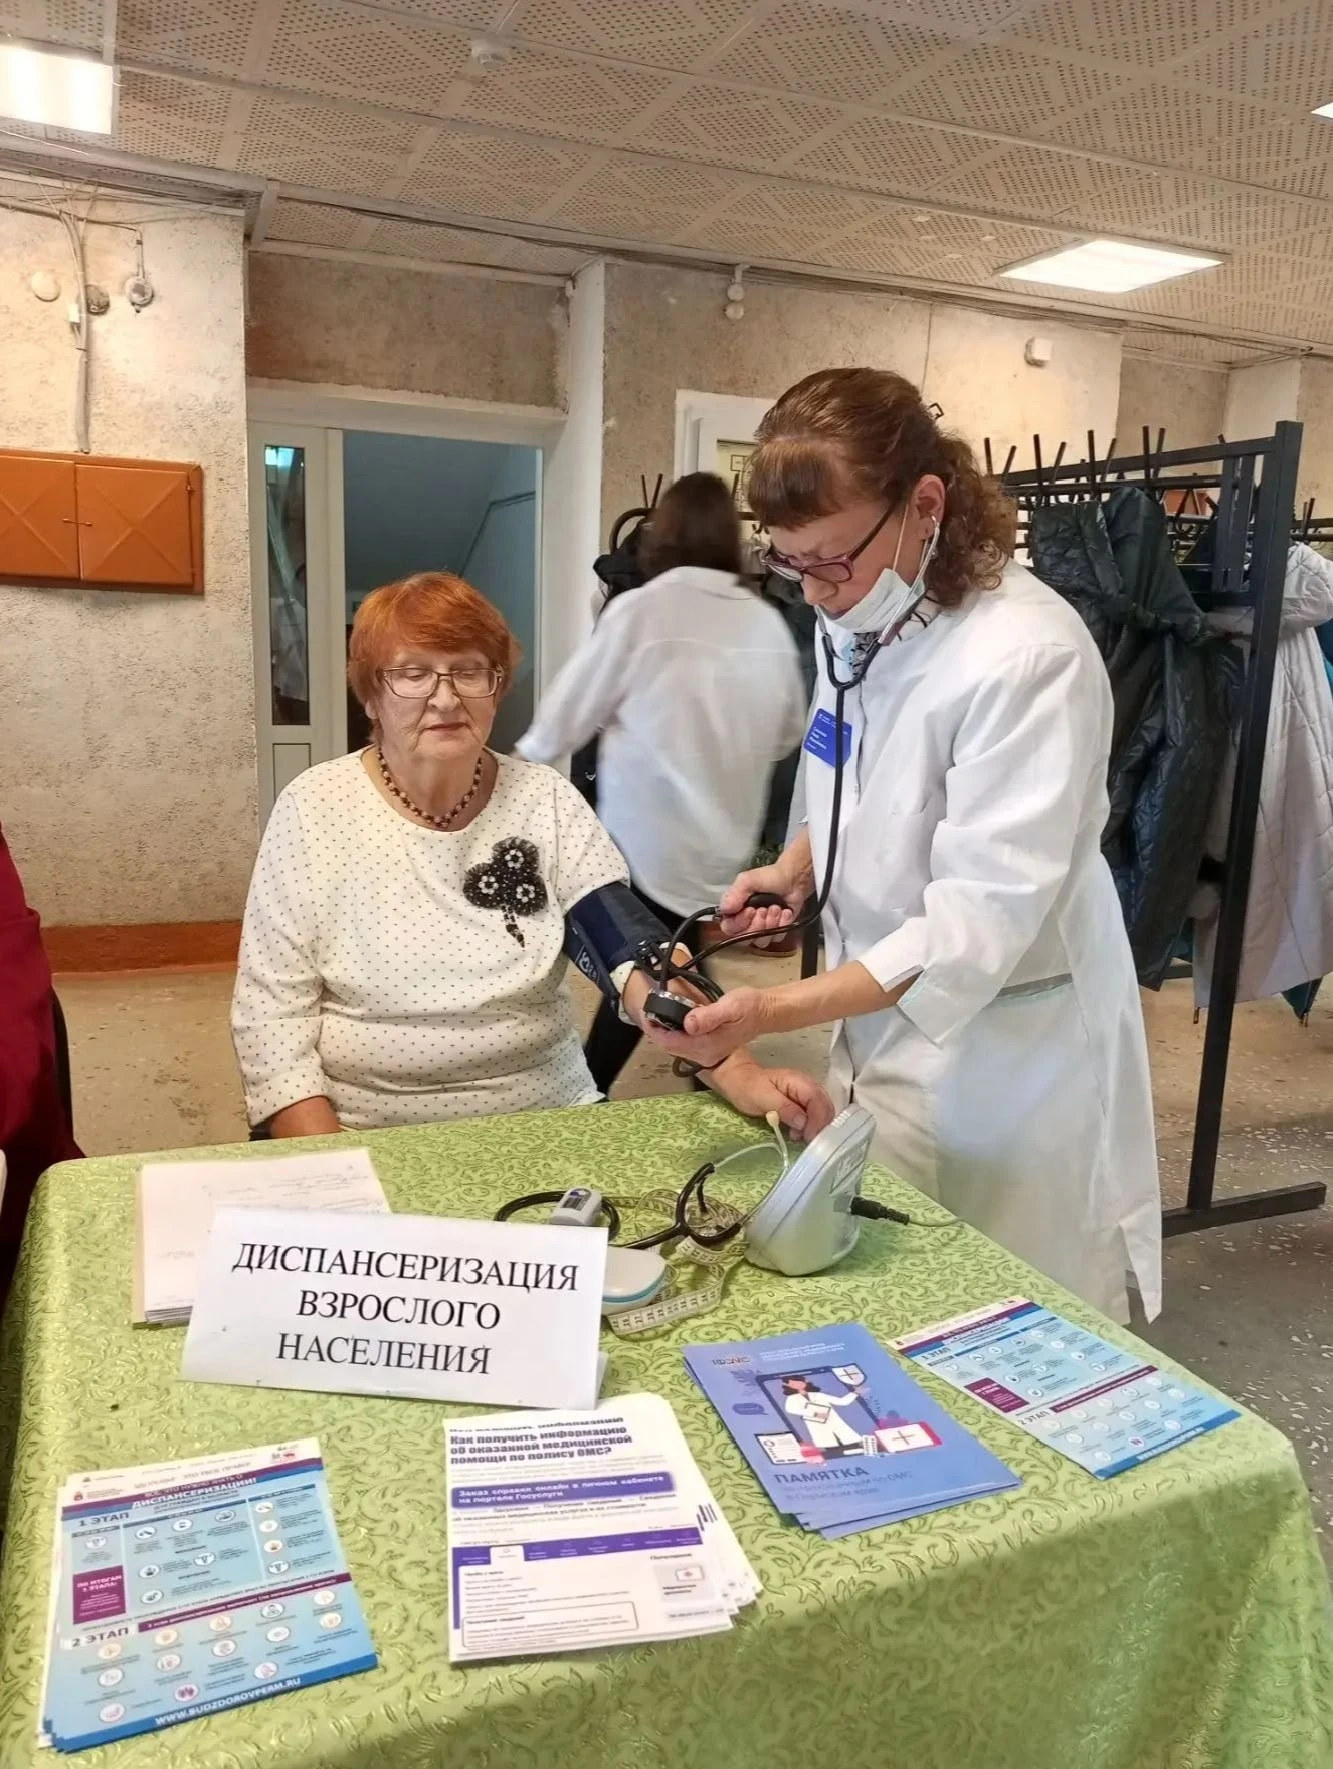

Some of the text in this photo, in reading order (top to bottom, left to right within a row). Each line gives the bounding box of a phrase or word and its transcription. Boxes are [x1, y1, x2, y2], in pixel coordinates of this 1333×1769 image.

[231, 1243, 580, 1292] ДИСПАНСЕРИЗАЦИЯ
[296, 1290, 501, 1329] ВЗРОСЛОГО
[276, 1332, 492, 1374] НАСЕЛЕНИЯ
[450, 1435, 473, 1445] Как
[477, 1434, 537, 1444] получить
[540, 1426, 627, 1440] информацию
[450, 1435, 633, 1455] об оказанной медицинской
[450, 1455, 507, 1465] помощи
[528, 1451, 575, 1461] полису
[577, 1446, 612, 1457] ОМС?
[773, 1467, 870, 1483] ПАМЯТКА
[132, 1477, 257, 1509] ДИСПАНСЕРИЗАЦИИ!
[492, 1487, 532, 1496] справки
[582, 1480, 617, 1488] личном
[621, 1476, 664, 1484] кабинете
[473, 1495, 513, 1504] портале
[515, 1491, 564, 1500] Госуслуги
[79, 1512, 130, 1527] 1 ЭТАП
[72, 1627, 129, 1647] 2 ЭТАП
